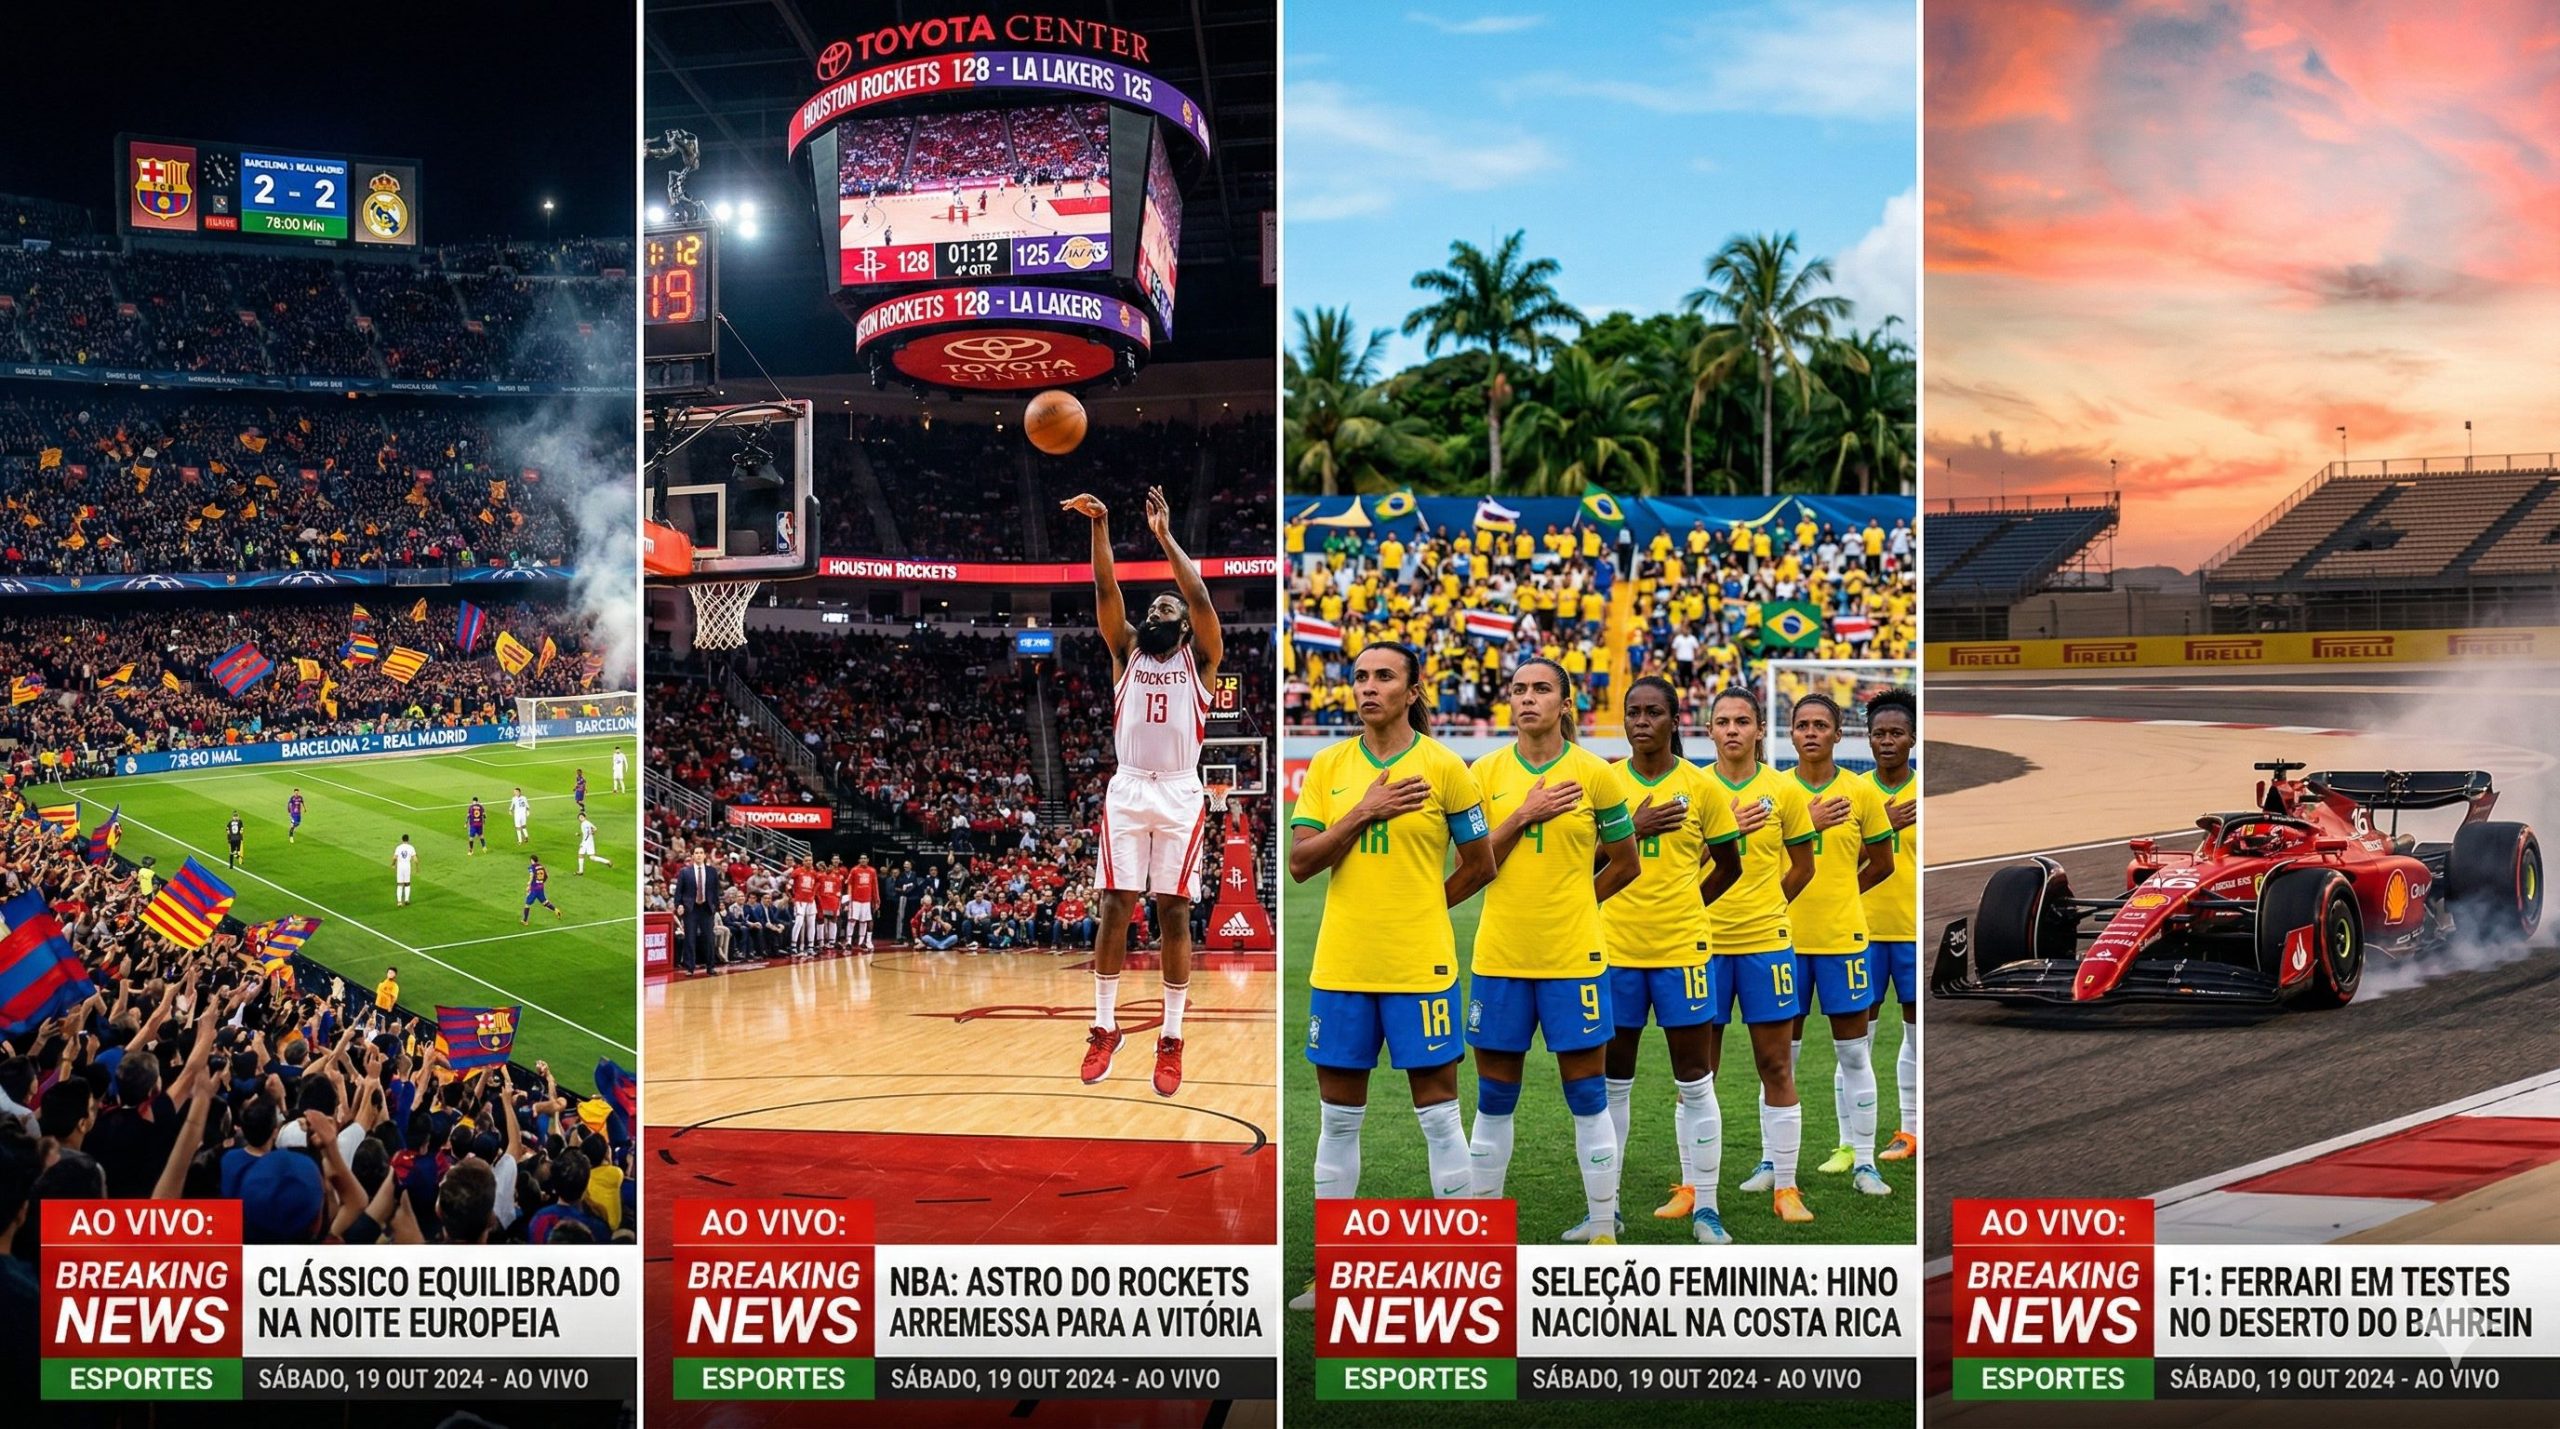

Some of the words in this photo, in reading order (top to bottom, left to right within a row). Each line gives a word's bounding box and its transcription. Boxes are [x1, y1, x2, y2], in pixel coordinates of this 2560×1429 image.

[857, 14, 996, 60] TOYOTA
[1004, 14, 1150, 64] CENTER
[803, 79, 857, 130] HOUSTON
[861, 61, 941, 101] ROCKETS
[952, 56, 990, 83] 128
[1012, 57, 1038, 81] LA
[1042, 58, 1115, 92] LAKERS
[1123, 72, 1153, 103] 125
[254, 174, 275, 205] 2
[314, 179, 336, 209] 2
[265, 216, 301, 230] 78:00
[897, 250, 930, 273] 128
[948, 242, 998, 263] 01:12
[1017, 244, 1050, 267] 125
[969, 264, 992, 276] QTR
[652, 269, 692, 320] 19
[879, 295, 945, 331] ROCKETS
[953, 291, 990, 317] 128
[1010, 291, 1034, 313] LA
[1037, 291, 1102, 321] LAKERS
[942, 358, 1076, 374] TOYOTA
[951, 367, 1080, 383] CENTER
[829, 560, 893, 577] HOUSTON
[895, 562, 957, 579] ROCKETS
[1950, 645, 2021, 666] PIRELLI
[2063, 642, 2138, 664] PIRELLI
[2185, 639, 2263, 661] PIRELLI
[2313, 636, 2394, 658] PIRELLI
[1134, 670, 1187, 685] ROCKETS
[1145, 693, 1168, 723] 13
[575, 716, 636, 733] BARCELON
[281, 738, 359, 758] BARCELONA
[362, 736, 370, 750] 2
[383, 733, 416, 749] REAL
[418, 729, 468, 745] MADRID
[746, 811, 787, 823] TOYOTA
[1580, 984, 1600, 1020] 9
